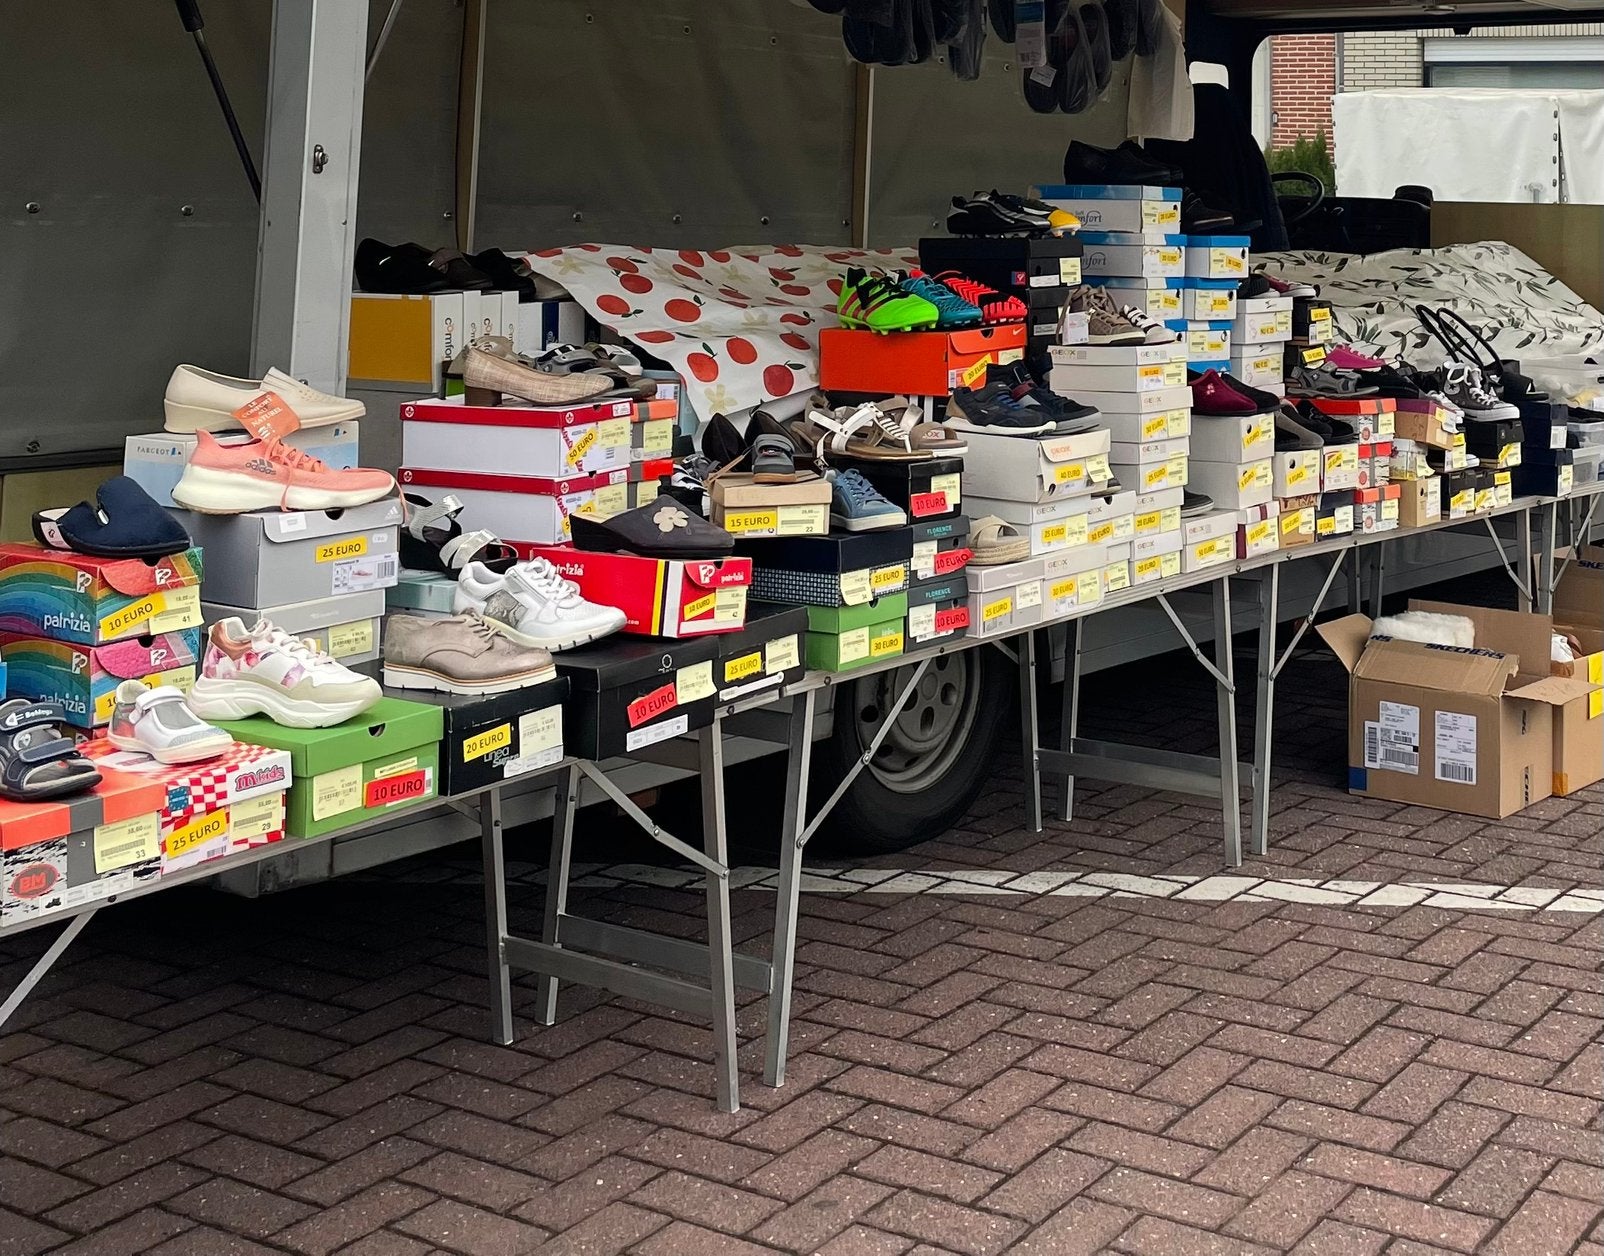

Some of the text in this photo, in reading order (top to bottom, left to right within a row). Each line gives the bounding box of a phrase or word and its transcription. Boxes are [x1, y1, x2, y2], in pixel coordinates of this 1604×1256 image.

[444, 317, 454, 360] comfor
[577, 432, 594, 452] EURO
[245, 462, 276, 475] adidas
[916, 496, 946, 510] 10 EURO
[730, 516, 770, 528] 15 EURO
[1051, 527, 1065, 537] EURO
[322, 543, 361, 558] 25 EURO
[936, 553, 970, 569] 10 EURO
[874, 570, 900, 583] 25 EURO
[925, 587, 951, 598] FLORENCE
[108, 602, 154, 632] 10 EURO
[985, 602, 1008, 618] 25 EURO
[44, 611, 91, 632] patrizia
[937, 612, 966, 628] 10 EURO
[874, 638, 899, 651] 30 EURO
[1424, 642, 1506, 659] SKECHERS
[730, 658, 758, 675] 25 EURO
[634, 690, 675, 720] 10 EURO
[466, 741, 478, 754] 20
[479, 731, 504, 748] EURO
[373, 786, 388, 801] 10
[390, 778, 423, 797] EURO
[172, 820, 220, 852] 25 EURO
